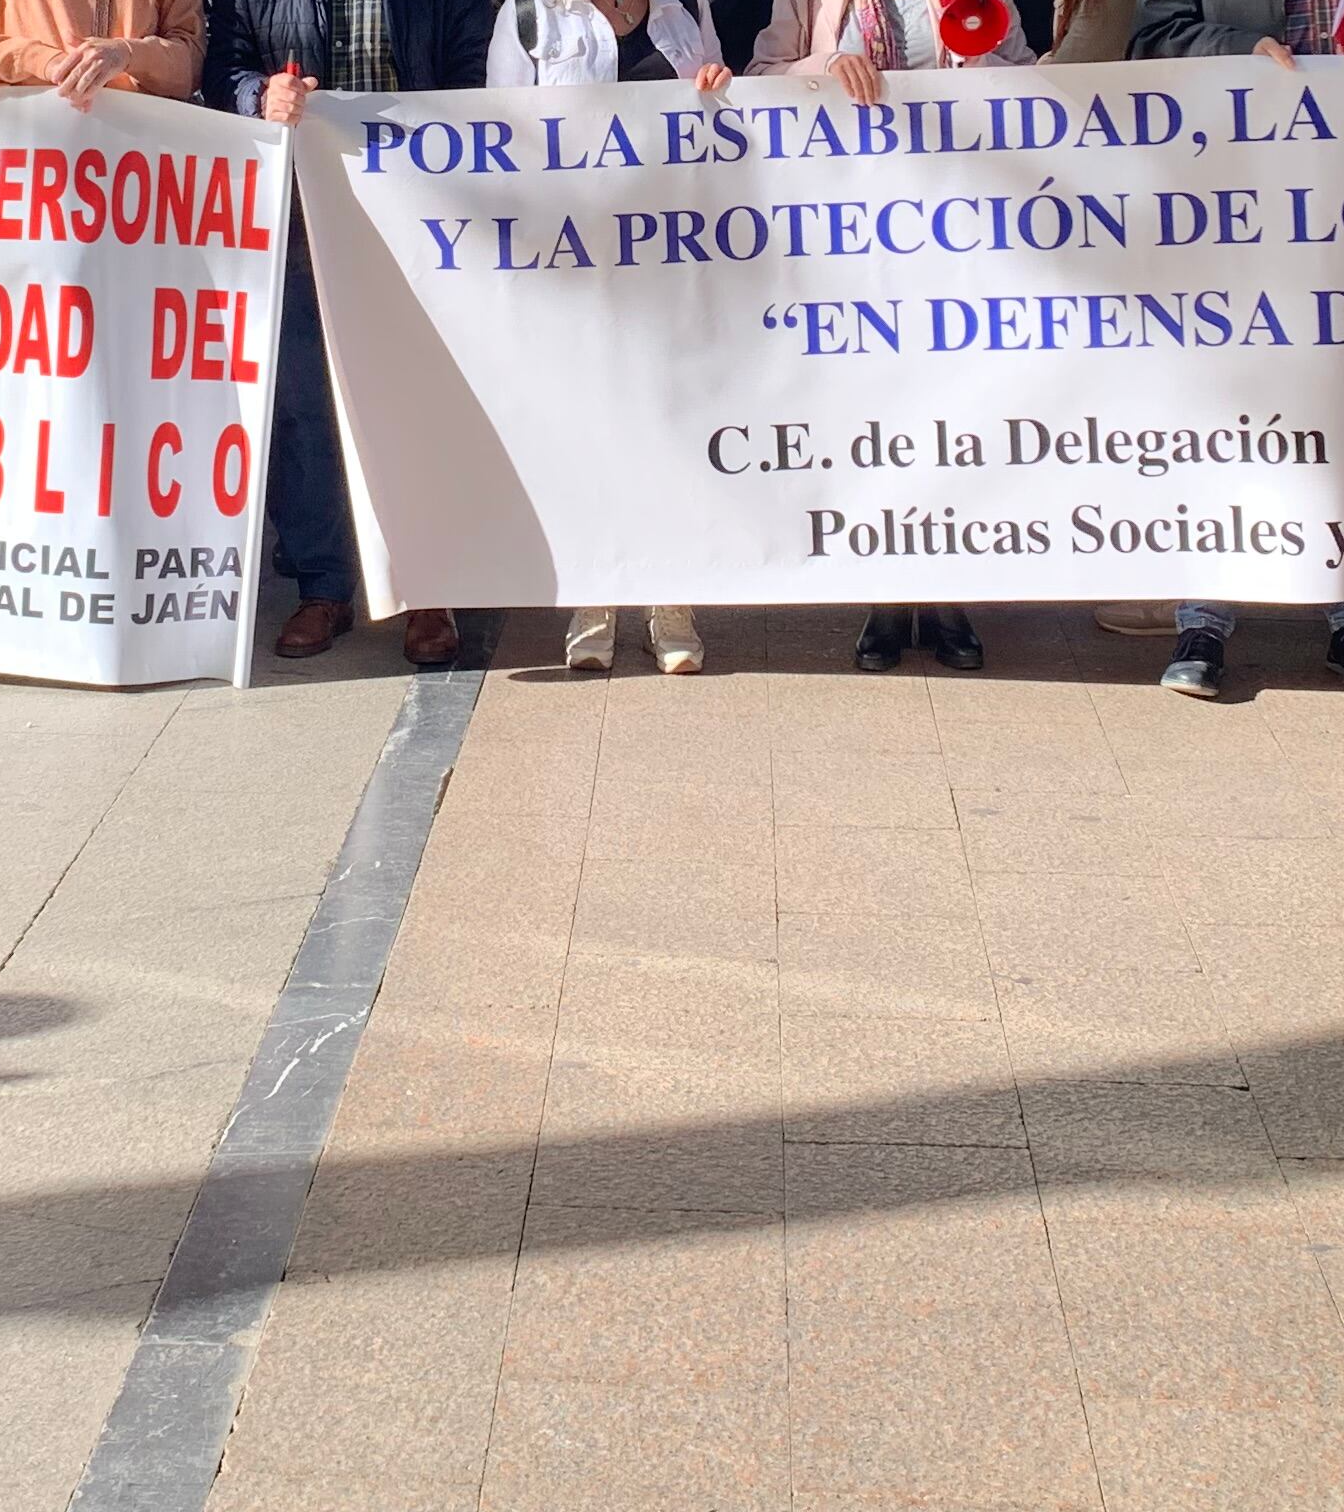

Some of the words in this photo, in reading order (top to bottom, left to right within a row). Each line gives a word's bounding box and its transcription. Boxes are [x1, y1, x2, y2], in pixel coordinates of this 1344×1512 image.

[365, 121, 518, 173] POR
[544, 116, 640, 170] LA
[664, 93, 1206, 164] ESTABILIDAD,
[1226, 89, 1333, 142] LA
[424, 220, 468, 269] Y
[496, 208, 597, 269] LA
[618, 179, 1126, 265] PROTECCIÓN
[1158, 190, 1261, 245] DE
[150, 287, 259, 383] DEL
[929, 293, 1290, 351] DEFENSA
[708, 423, 832, 474] C.E.
[851, 421, 915, 468] de
[934, 420, 986, 467] la
[1003, 414, 1329, 477] Delegación
[806, 507, 1050, 556] Políticas
[1072, 504, 1303, 554] Sociales
[135, 548, 239, 580] PARA
[61, 592, 115, 624] DE
[131, 584, 238, 625] JAÉN
